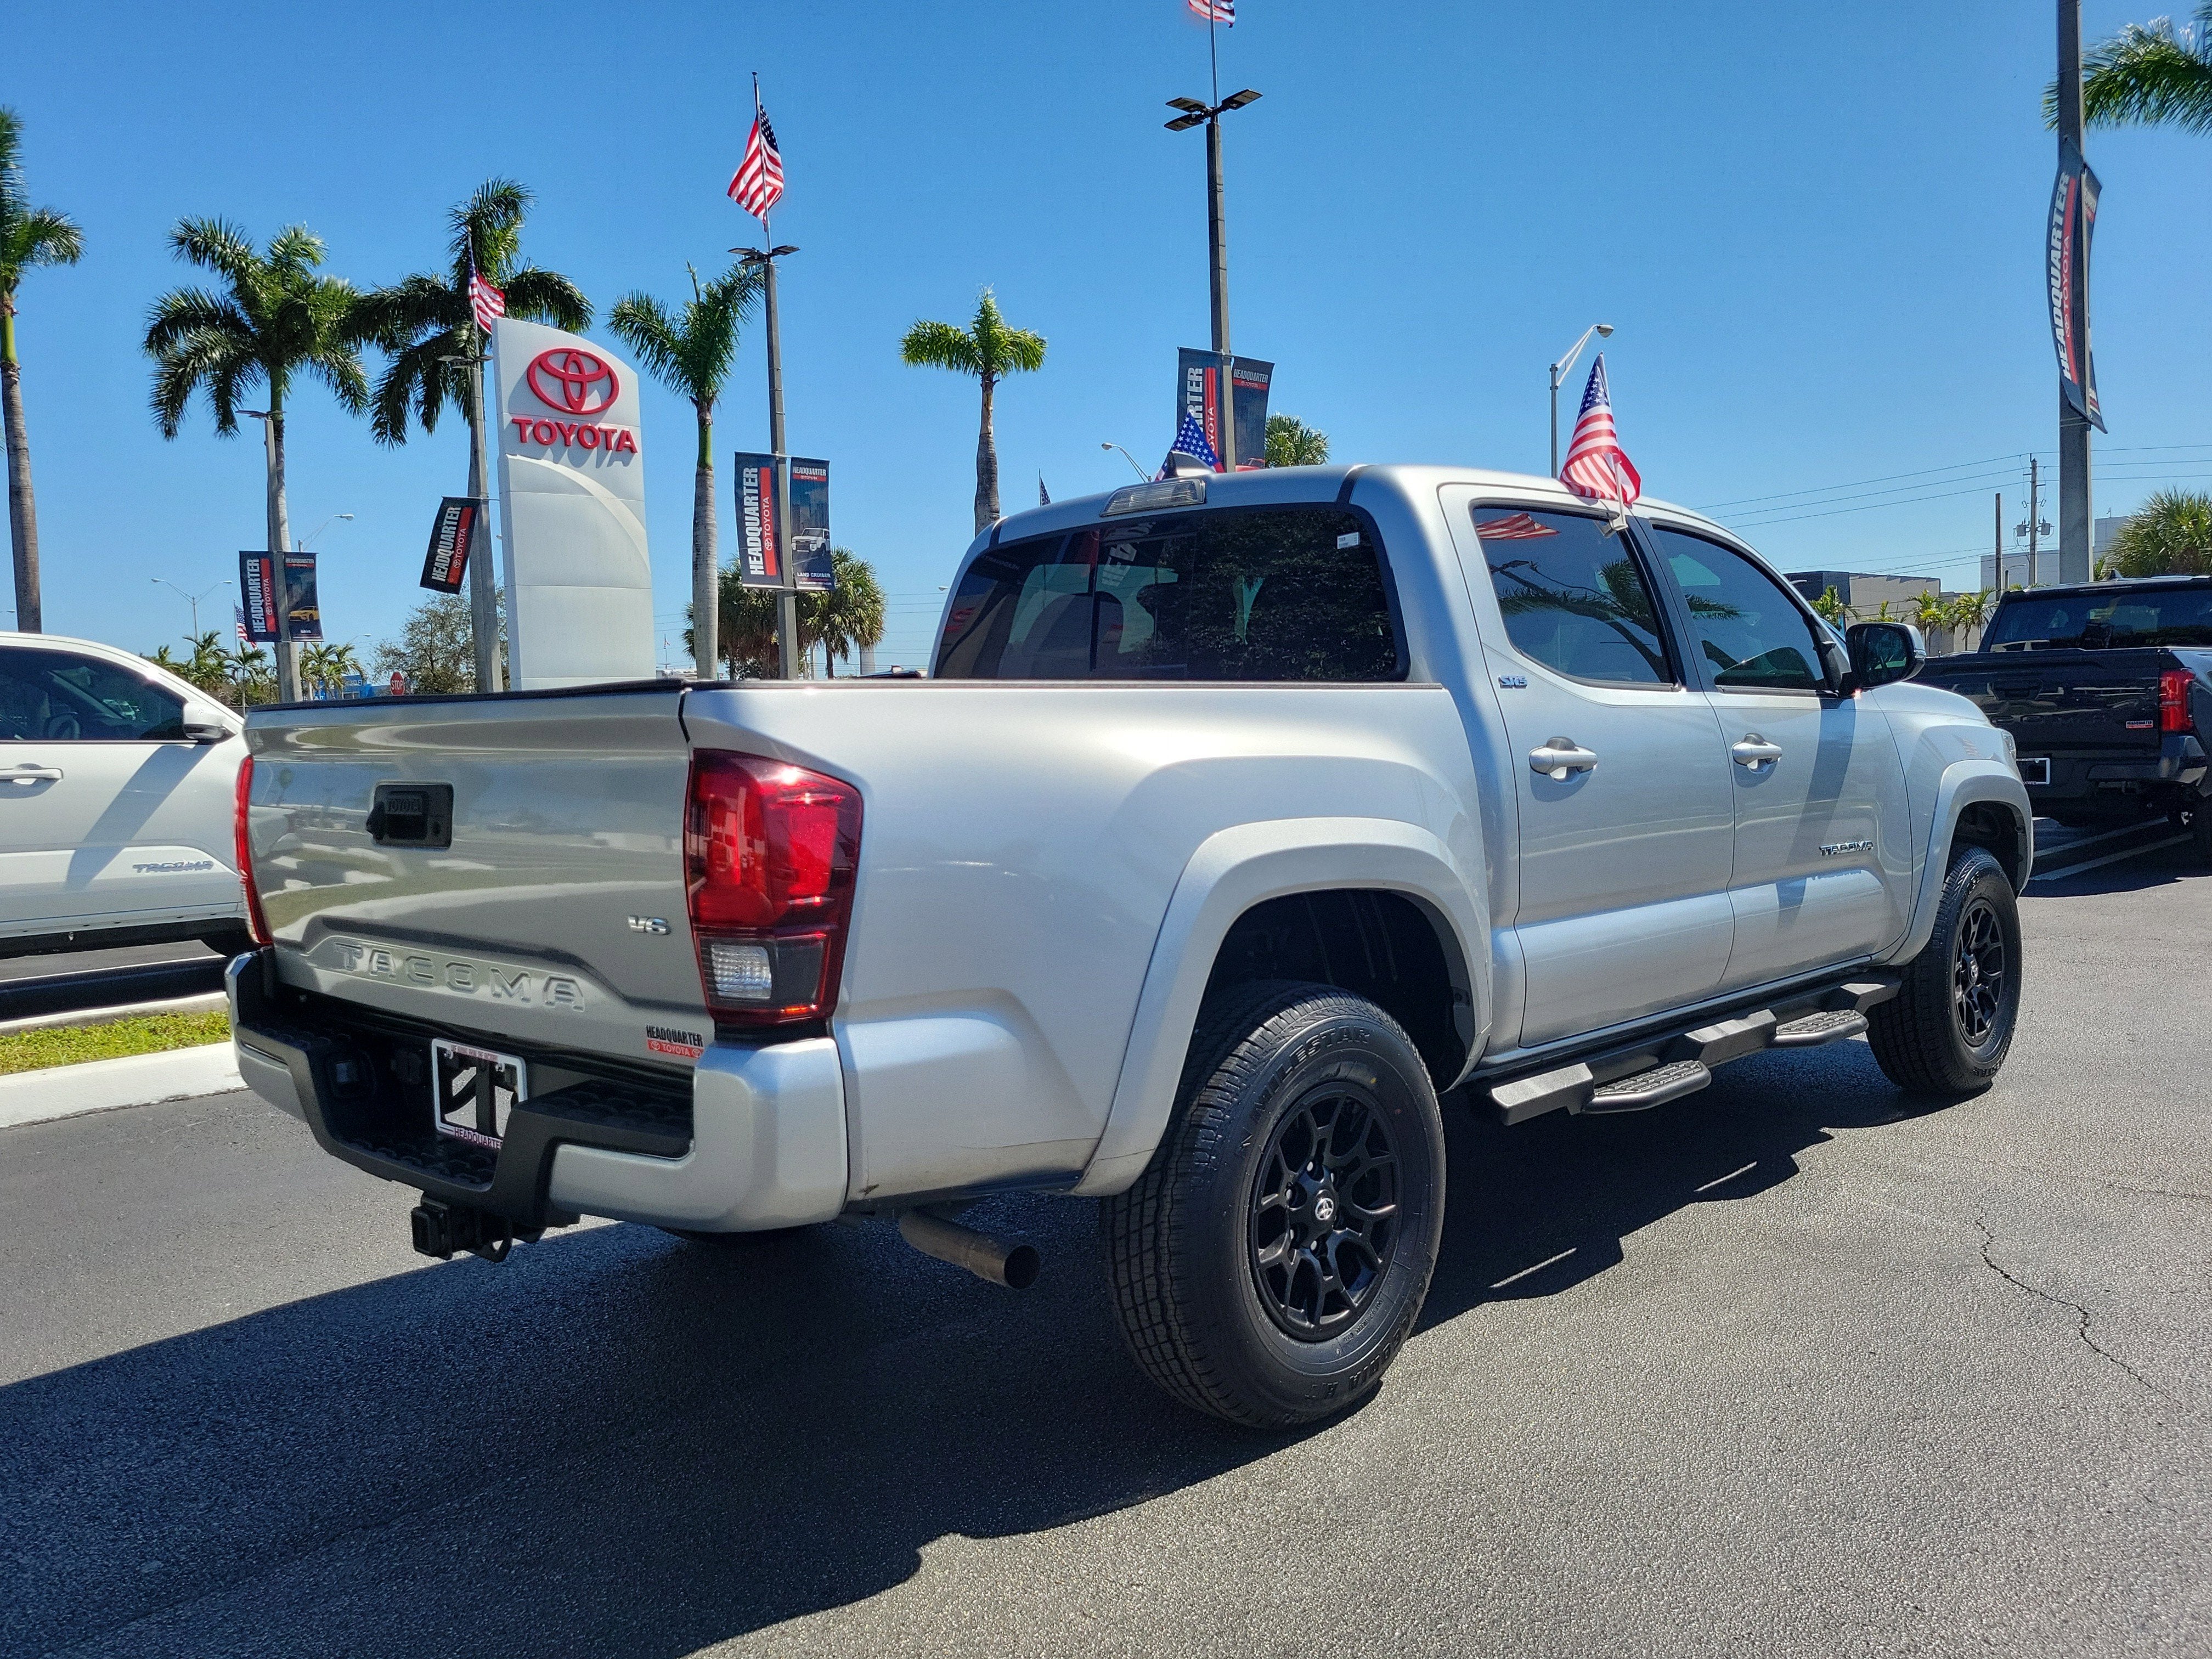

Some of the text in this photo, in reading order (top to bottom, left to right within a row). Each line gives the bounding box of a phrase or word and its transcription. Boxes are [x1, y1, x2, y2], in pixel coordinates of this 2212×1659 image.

[2050, 172, 2072, 381] HEADQUARTER
[1233, 369, 1269, 383] HEADQUARTER
[512, 418, 638, 453] TOYOTA
[793, 466, 826, 476] HEADQUARTER
[743, 467, 765, 575] HEADQUARTER
[431, 507, 461, 582] HEADQUARTER
[455, 528, 466, 558] TOYOTA
[247, 558, 266, 633] HEADQUARTER
[263, 578, 271, 606] TOYOTA
[391, 680, 403, 690] STOP
[628, 915, 671, 936] V6
[334, 941, 585, 1012] TACOMA
[646, 1024, 703, 1047] HEADQUARTER
[662, 1043, 691, 1056] TOYOTA
